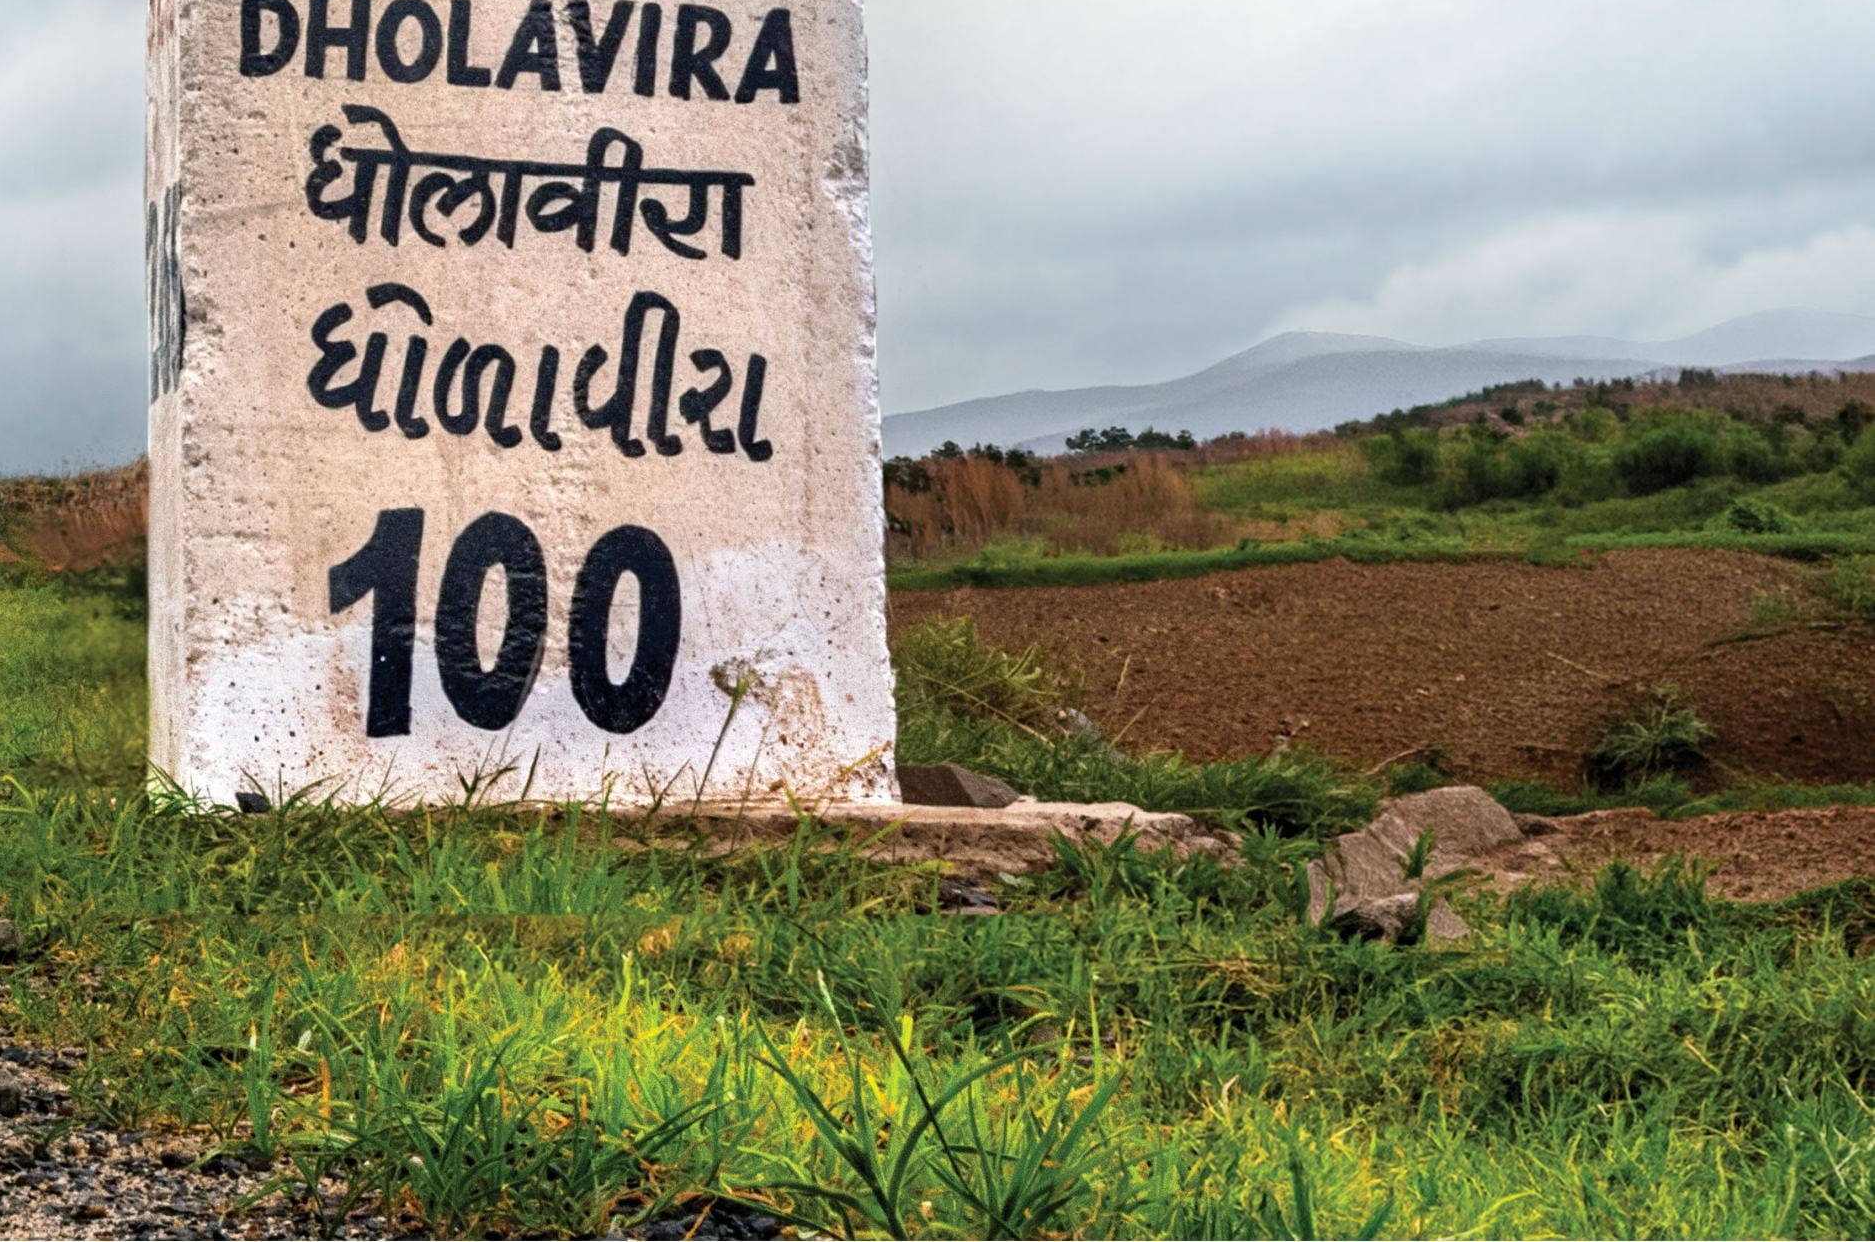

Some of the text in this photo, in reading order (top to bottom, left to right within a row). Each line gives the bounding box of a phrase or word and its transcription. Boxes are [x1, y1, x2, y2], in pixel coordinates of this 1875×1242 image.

[305, 104, 756, 260] धोलावीरा
[306, 282, 773, 462] ધોળાવીરા
[329, 508, 681, 738] 100
